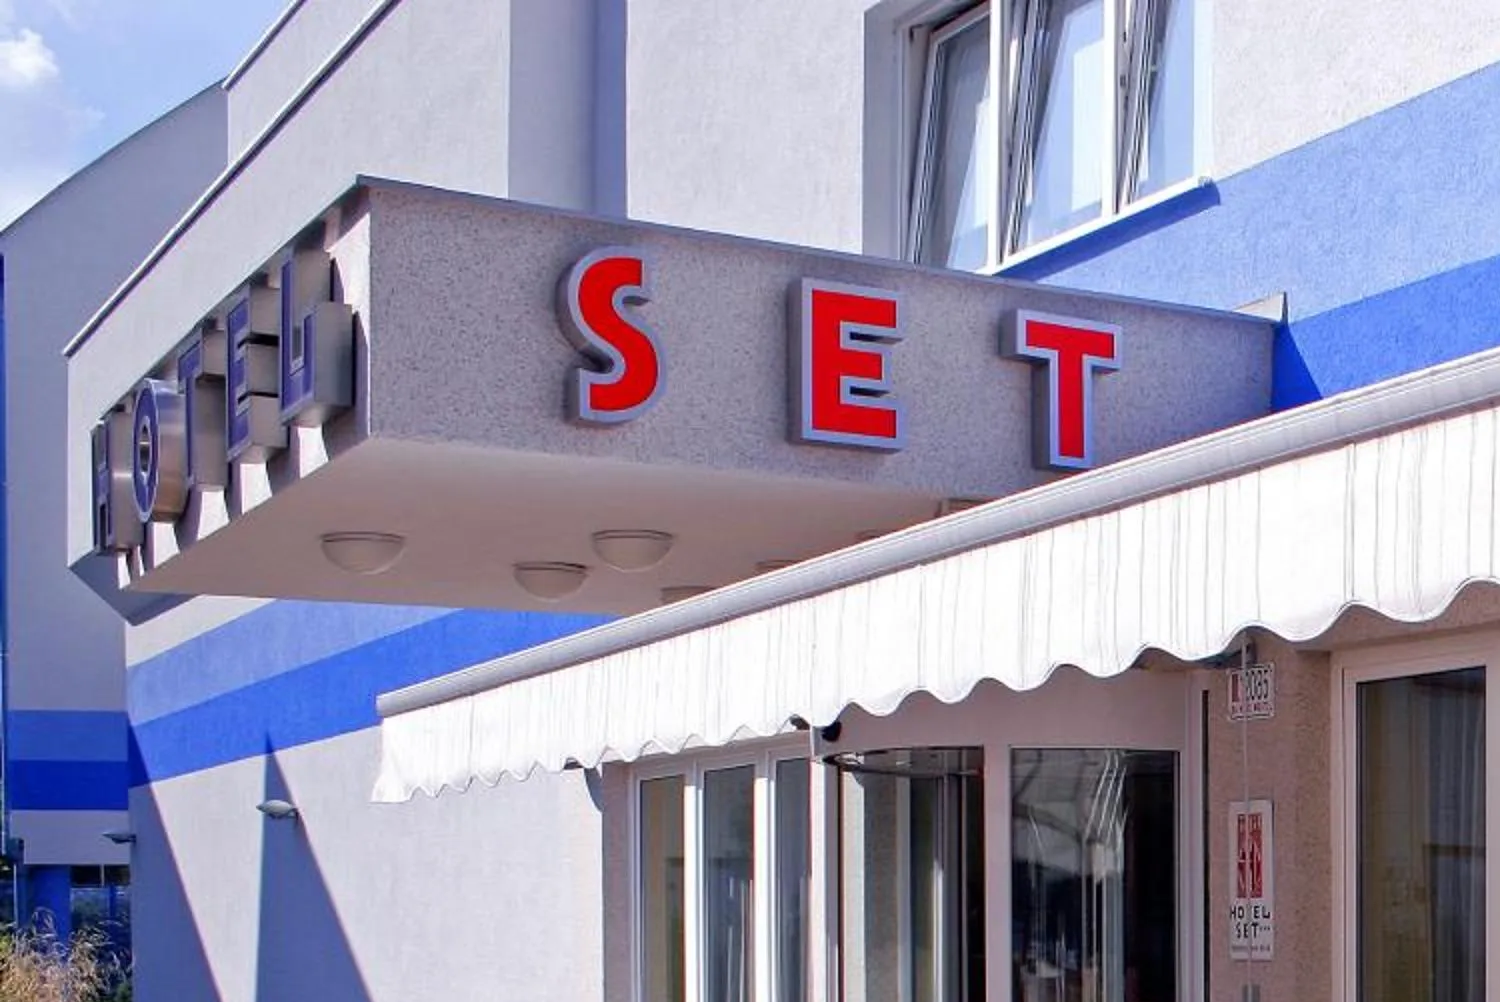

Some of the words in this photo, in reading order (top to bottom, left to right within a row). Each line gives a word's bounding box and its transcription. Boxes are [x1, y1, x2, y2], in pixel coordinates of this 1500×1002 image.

[92, 247, 320, 553] HOTEL
[563, 246, 1123, 470] SET
[1229, 905, 1271, 919] HOEL
